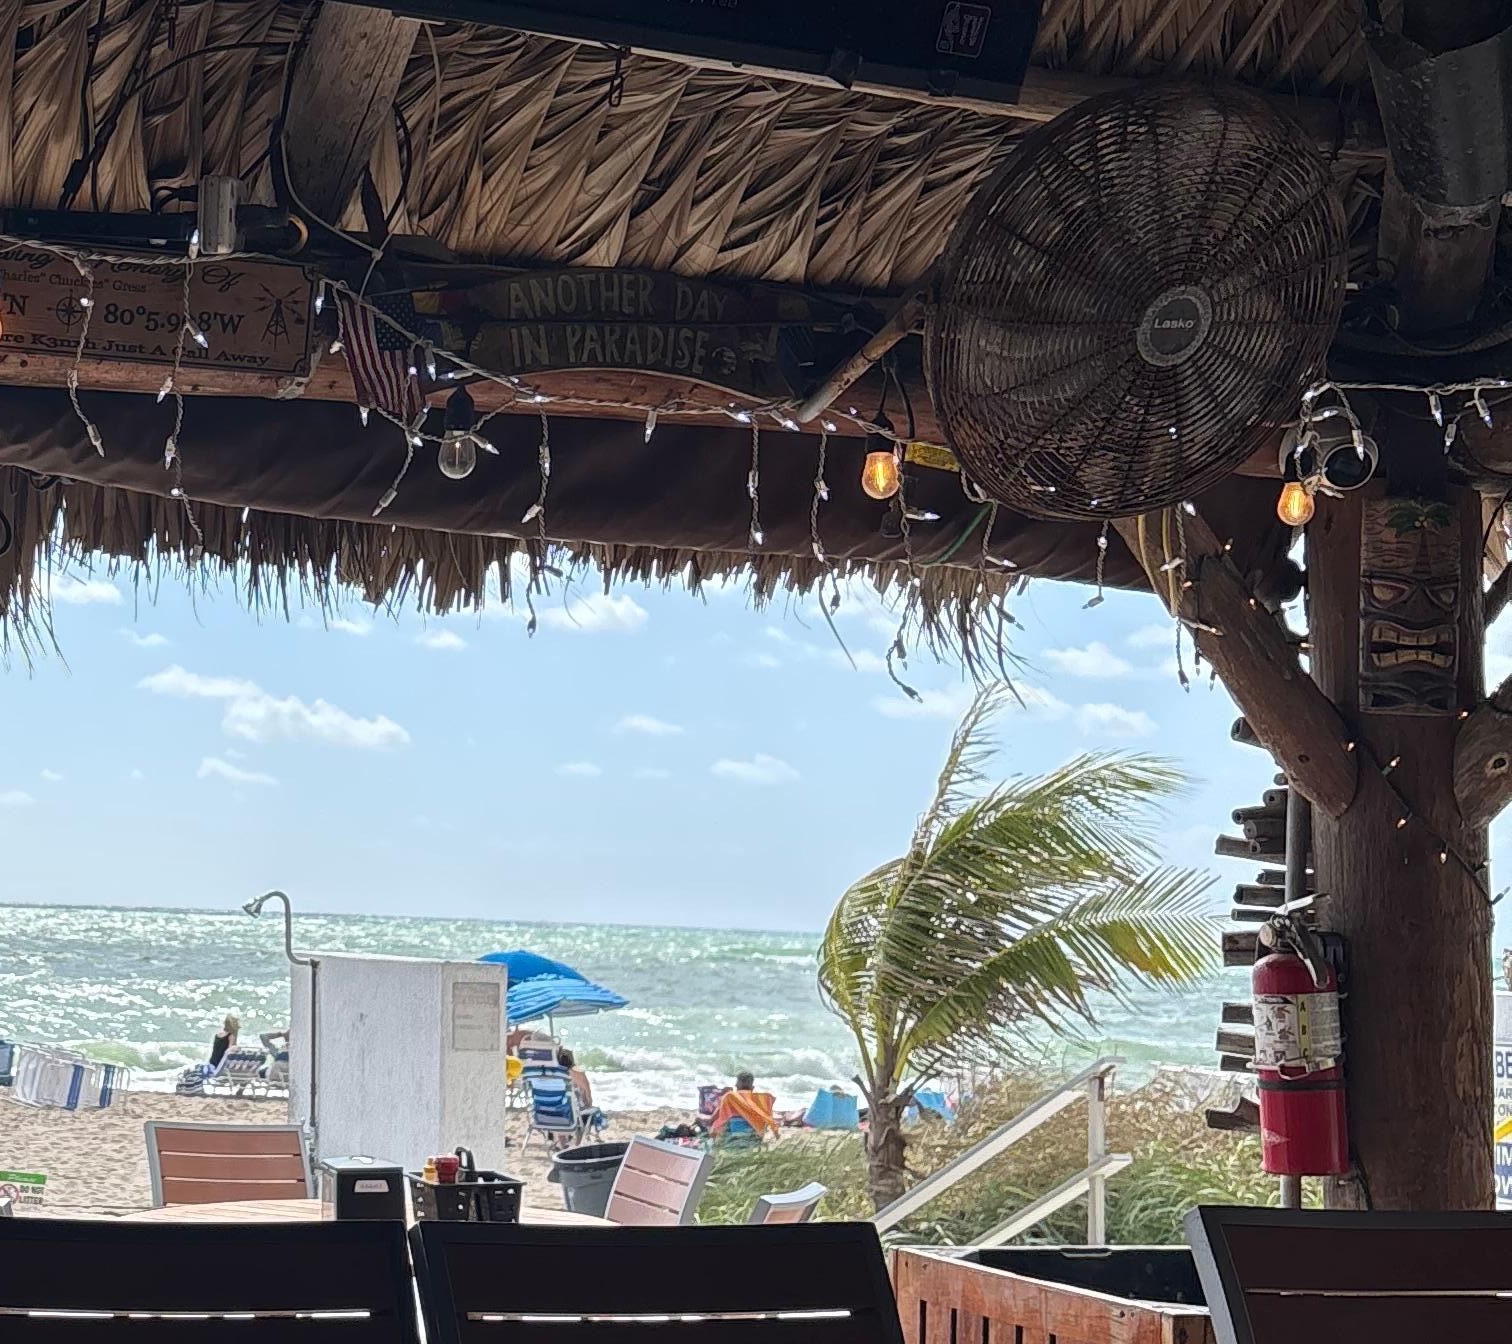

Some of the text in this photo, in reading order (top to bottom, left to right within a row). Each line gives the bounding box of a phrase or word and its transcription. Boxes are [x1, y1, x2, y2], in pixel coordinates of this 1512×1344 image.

[509, 272, 727, 321] ANOTHER DAY
[1153, 316, 1195, 331] Lasko
[102, 340, 145, 354] Just
[149, 343, 167, 356] A
[214, 350, 269, 366] Away
[511, 324, 710, 375] IN PARADISE
